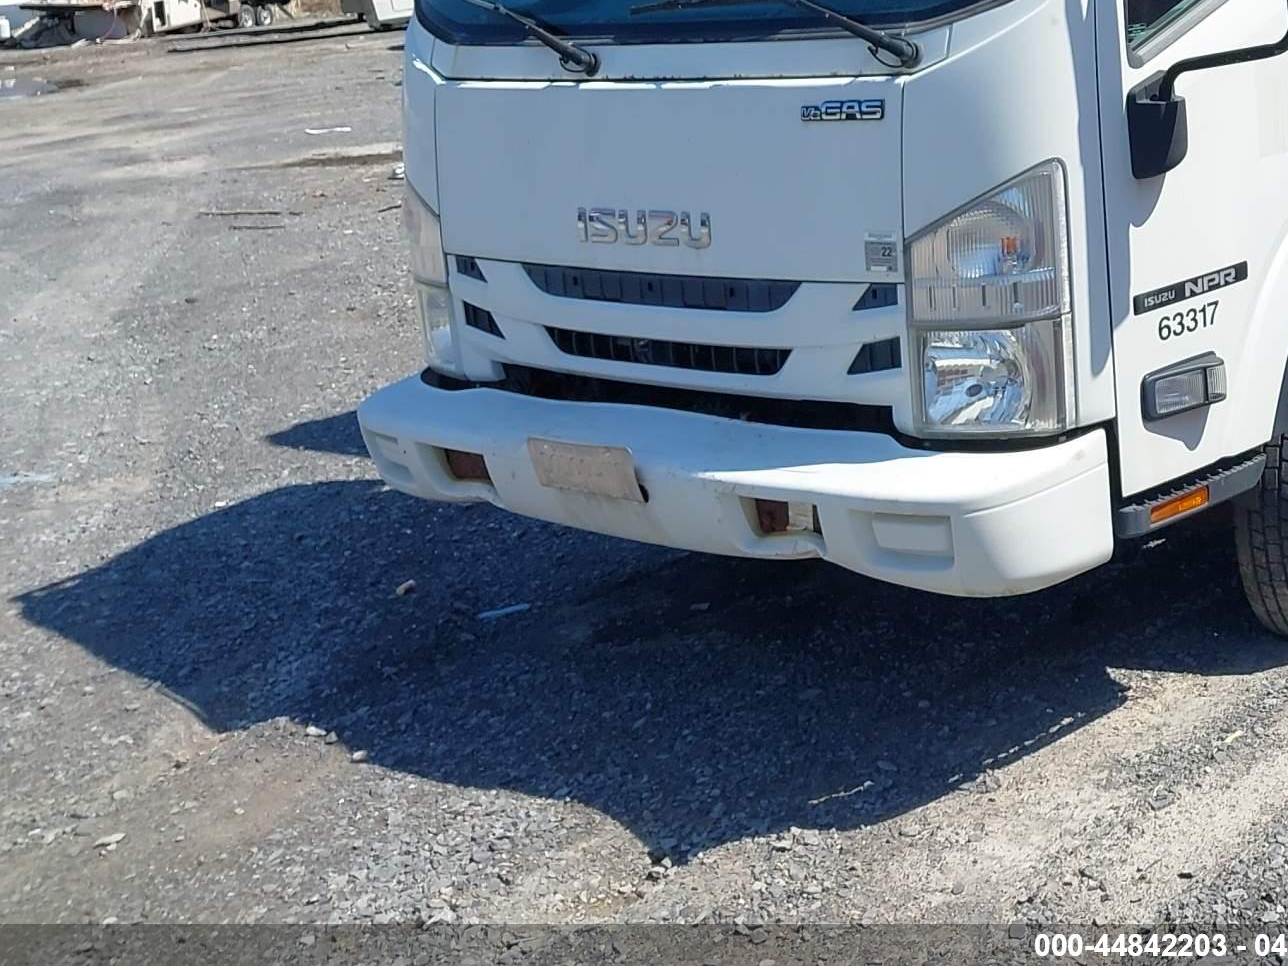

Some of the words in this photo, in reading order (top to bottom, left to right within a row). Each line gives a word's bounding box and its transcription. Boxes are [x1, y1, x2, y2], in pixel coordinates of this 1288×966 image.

[821, 100, 883, 121] GAS
[577, 207, 712, 249] ISUZU
[1143, 289, 1176, 308] ISUZU
[1184, 266, 1237, 298] NPR
[1157, 299, 1220, 341] 63317
